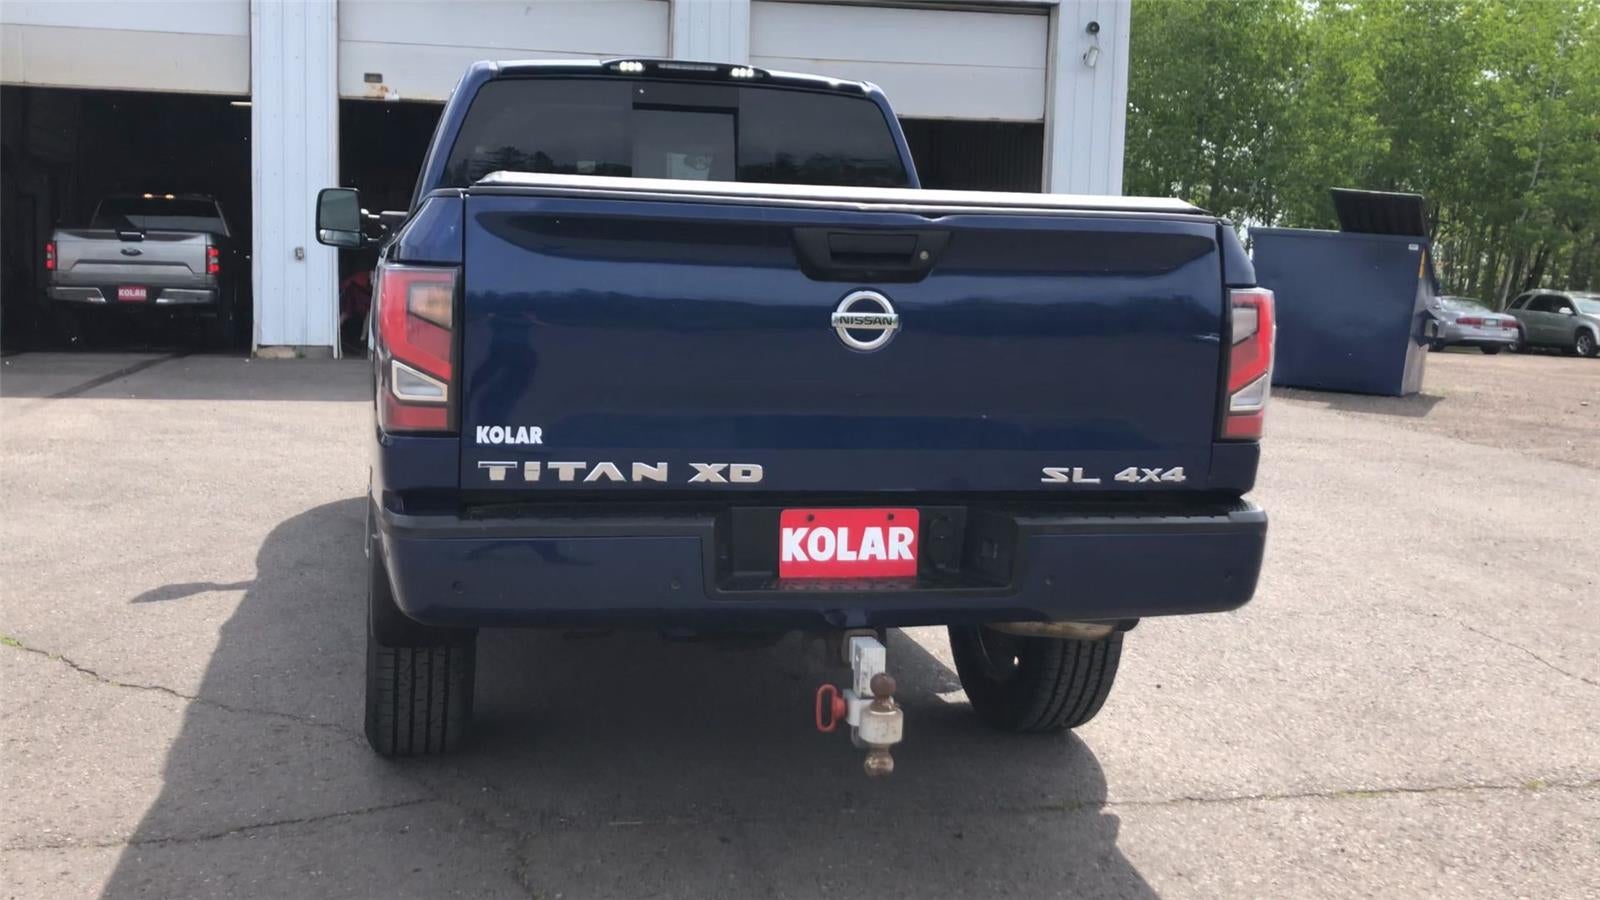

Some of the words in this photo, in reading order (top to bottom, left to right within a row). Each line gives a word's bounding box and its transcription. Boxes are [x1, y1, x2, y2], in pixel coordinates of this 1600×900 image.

[118, 288, 147, 297] KOLAR
[839, 315, 893, 326] NISSAN
[476, 426, 543, 444] KOLAR
[477, 461, 669, 483] TITAN
[687, 463, 764, 484] XD
[1041, 466, 1101, 484] SL
[780, 526, 915, 562] KOLAR
